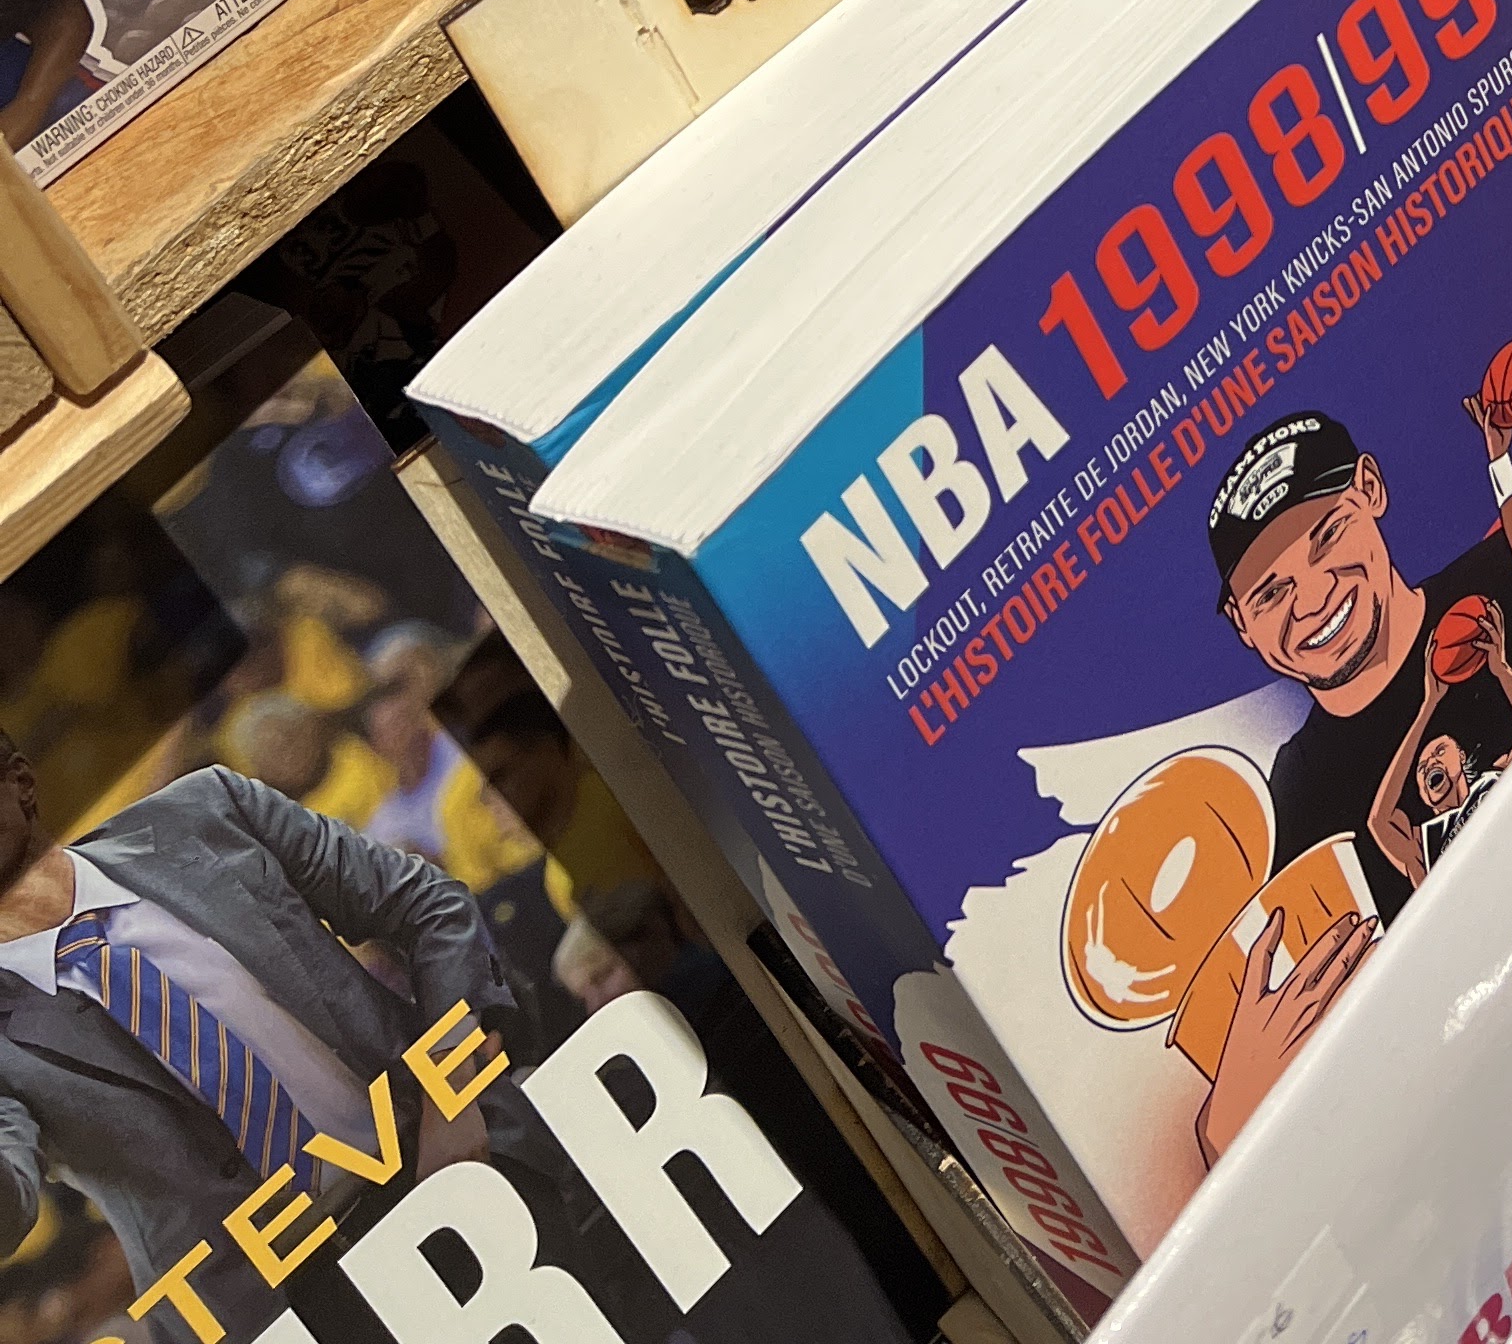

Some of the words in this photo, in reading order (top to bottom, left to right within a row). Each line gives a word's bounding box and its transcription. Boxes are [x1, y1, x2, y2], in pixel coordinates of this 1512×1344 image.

[31, 102, 95, 159] WARNING:
[95, 76, 139, 112] CHOKING
[138, 44, 179, 81] HAZARD.
[885, 588, 989, 701] LOCKOUT,
[981, 487, 1080, 594] RETRAITE
[1076, 457, 1110, 497] DE
[1104, 381, 1189, 473] JORDAN,
[1182, 328, 1232, 392] NEW
[1229, 279, 1287, 344] YORK
[1282, 174, 1393, 295] KNICKS-SAN
[1392, 101, 1470, 191] ANTONIO
[907, 538, 1089, 747] L'HISTOIRE
[1076, 440, 1185, 566] FOLLE
[1170, 356, 1277, 469] D'UNE
[1265, 238, 1385, 374] SAISON
[1209, 417, 1322, 529] CHAMPIONS
[799, 343, 1072, 650] NBA
[609, 577, 709, 685] FOLLE
[660, 589, 770, 731] HISTORIQUE
[687, 692, 834, 875] L'HISTOIRE
[752, 732, 828, 818] SAISON
[85, 998, 511, 1344] TEVE
[919, 1040, 1124, 1278] 1998/99
